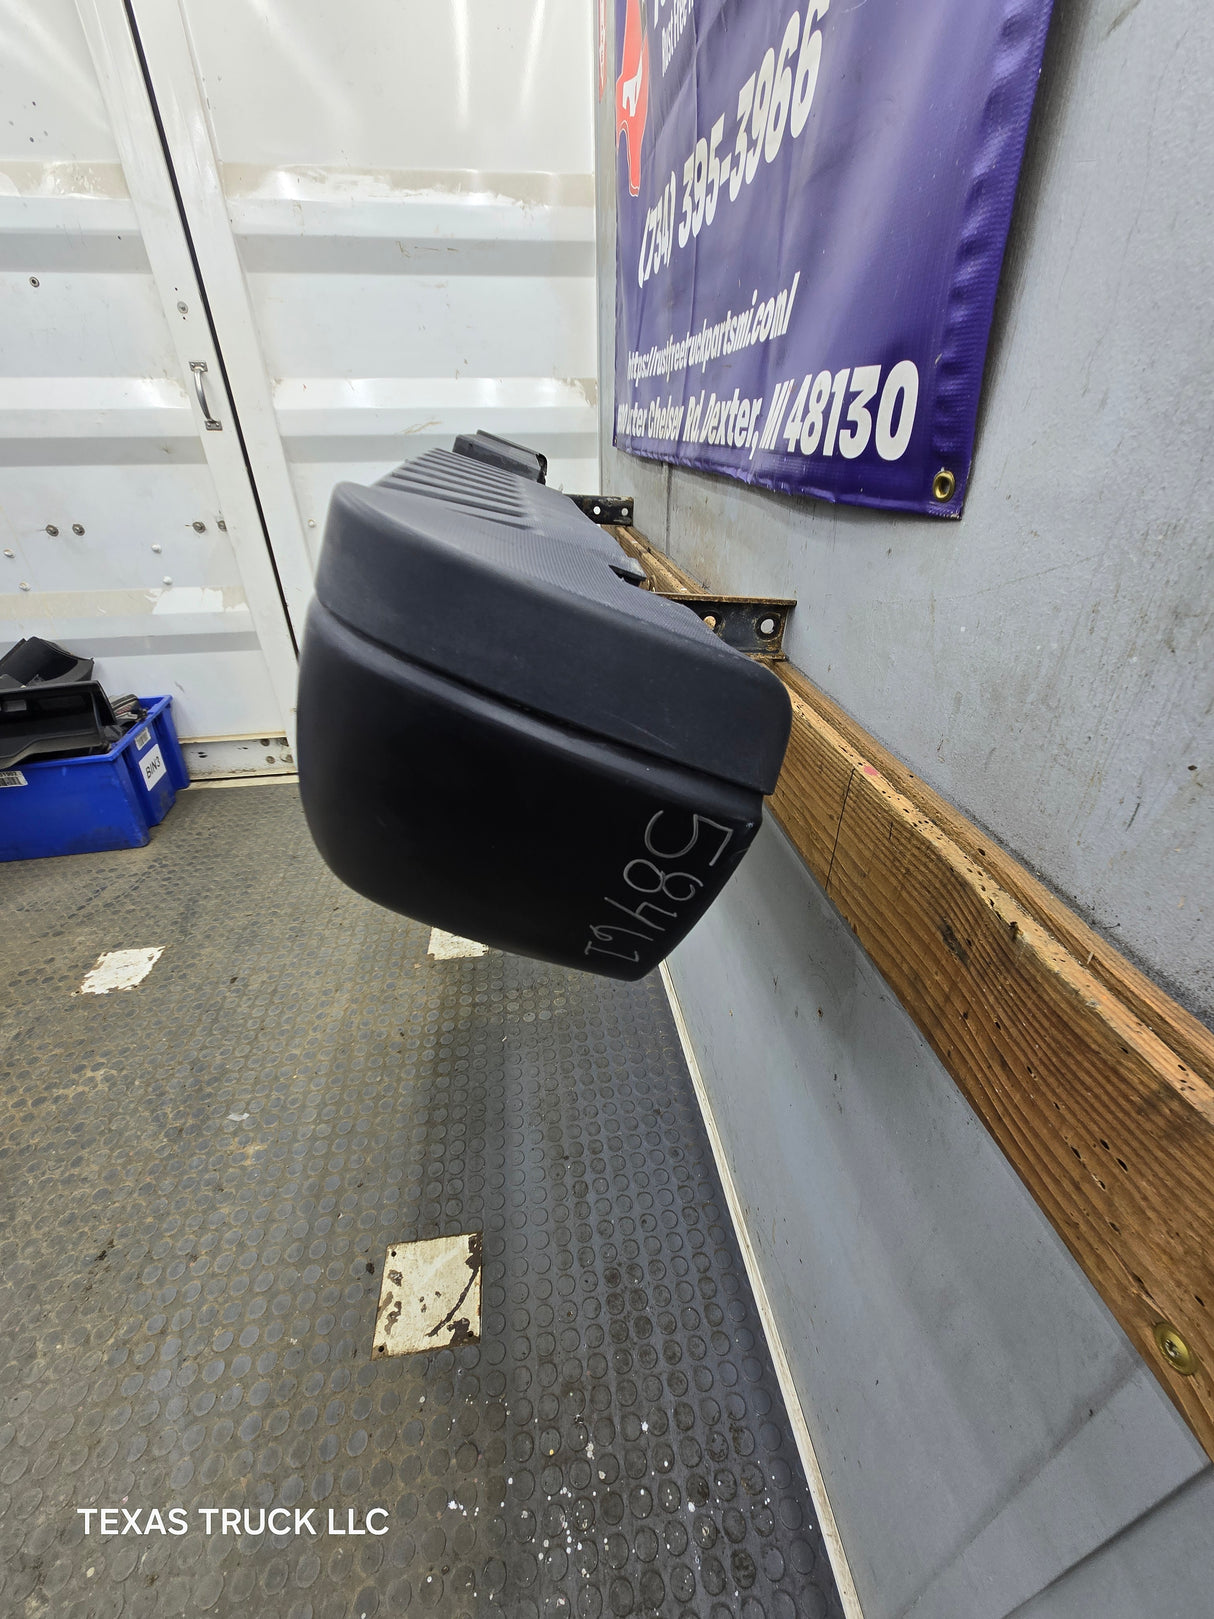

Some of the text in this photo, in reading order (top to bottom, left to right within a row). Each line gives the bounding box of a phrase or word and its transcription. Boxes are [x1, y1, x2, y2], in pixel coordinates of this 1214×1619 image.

[638, 0, 830, 288] (734) 395-3966
[699, 388, 763, 460] Dexter,
[783, 360, 919, 461] 48130
